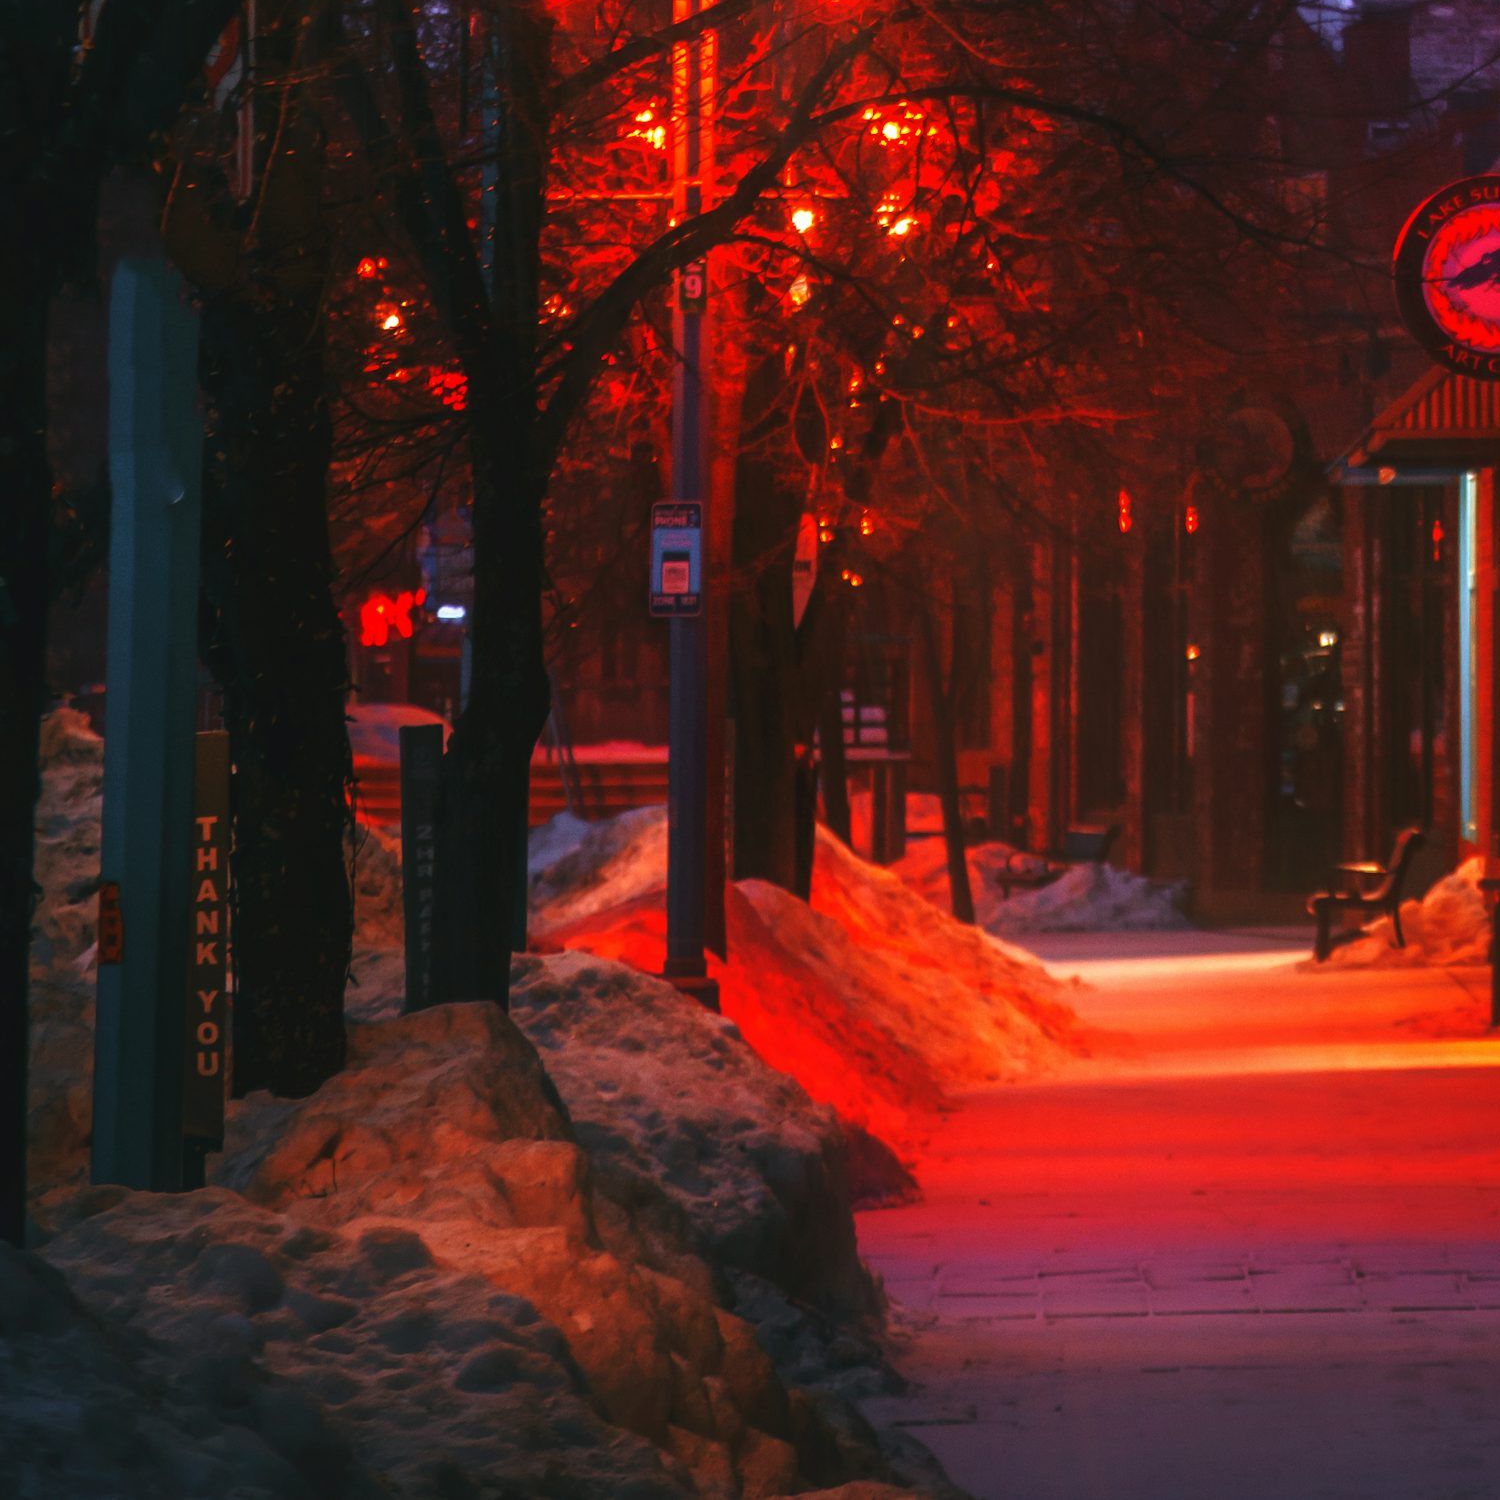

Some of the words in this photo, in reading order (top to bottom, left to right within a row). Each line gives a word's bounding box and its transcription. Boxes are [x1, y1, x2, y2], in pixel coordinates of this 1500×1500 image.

[1417, 194, 1464, 241] LAKE
[1441, 344, 1483, 371] ART
[195, 815, 219, 966] THANK
[196, 988, 219, 1078] YOU
